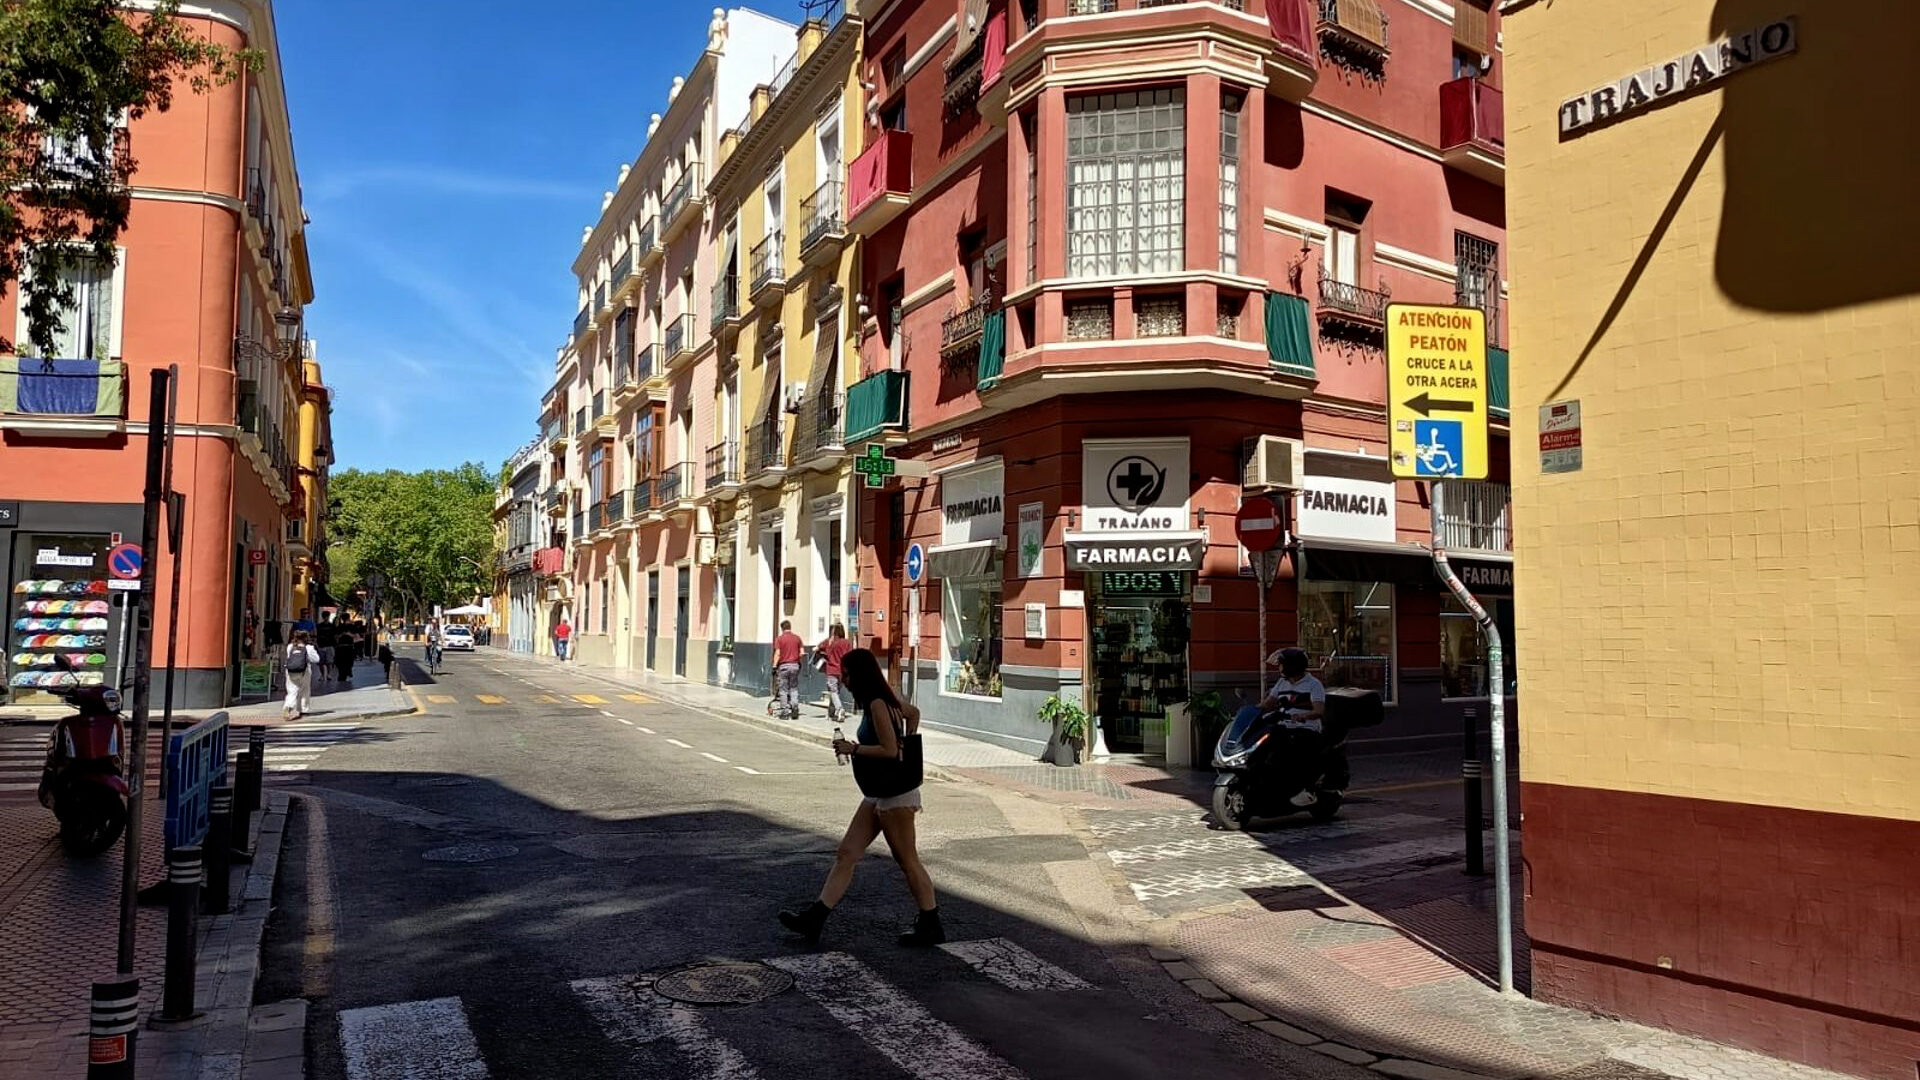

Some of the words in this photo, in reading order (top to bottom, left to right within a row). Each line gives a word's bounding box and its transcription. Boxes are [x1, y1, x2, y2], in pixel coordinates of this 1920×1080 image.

[1562, 21, 1790, 128] TRAJANO
[1399, 311, 1472, 330] ATENCIÓN
[1410, 333, 1467, 352] PEATÓN
[1407, 357, 1446, 370] CRUCE
[1449, 359, 1456, 370] A
[1459, 360, 1473, 371] LA
[1406, 375, 1437, 387] OTRA
[1440, 376, 1477, 389] ACERA
[946, 495, 1001, 525] FARMACIA
[1303, 489, 1388, 517] FARMACIA
[1098, 517, 1172, 529] TRAJANO
[1076, 547, 1192, 564] FARMACIA
[1462, 566, 1514, 587] FARMA
